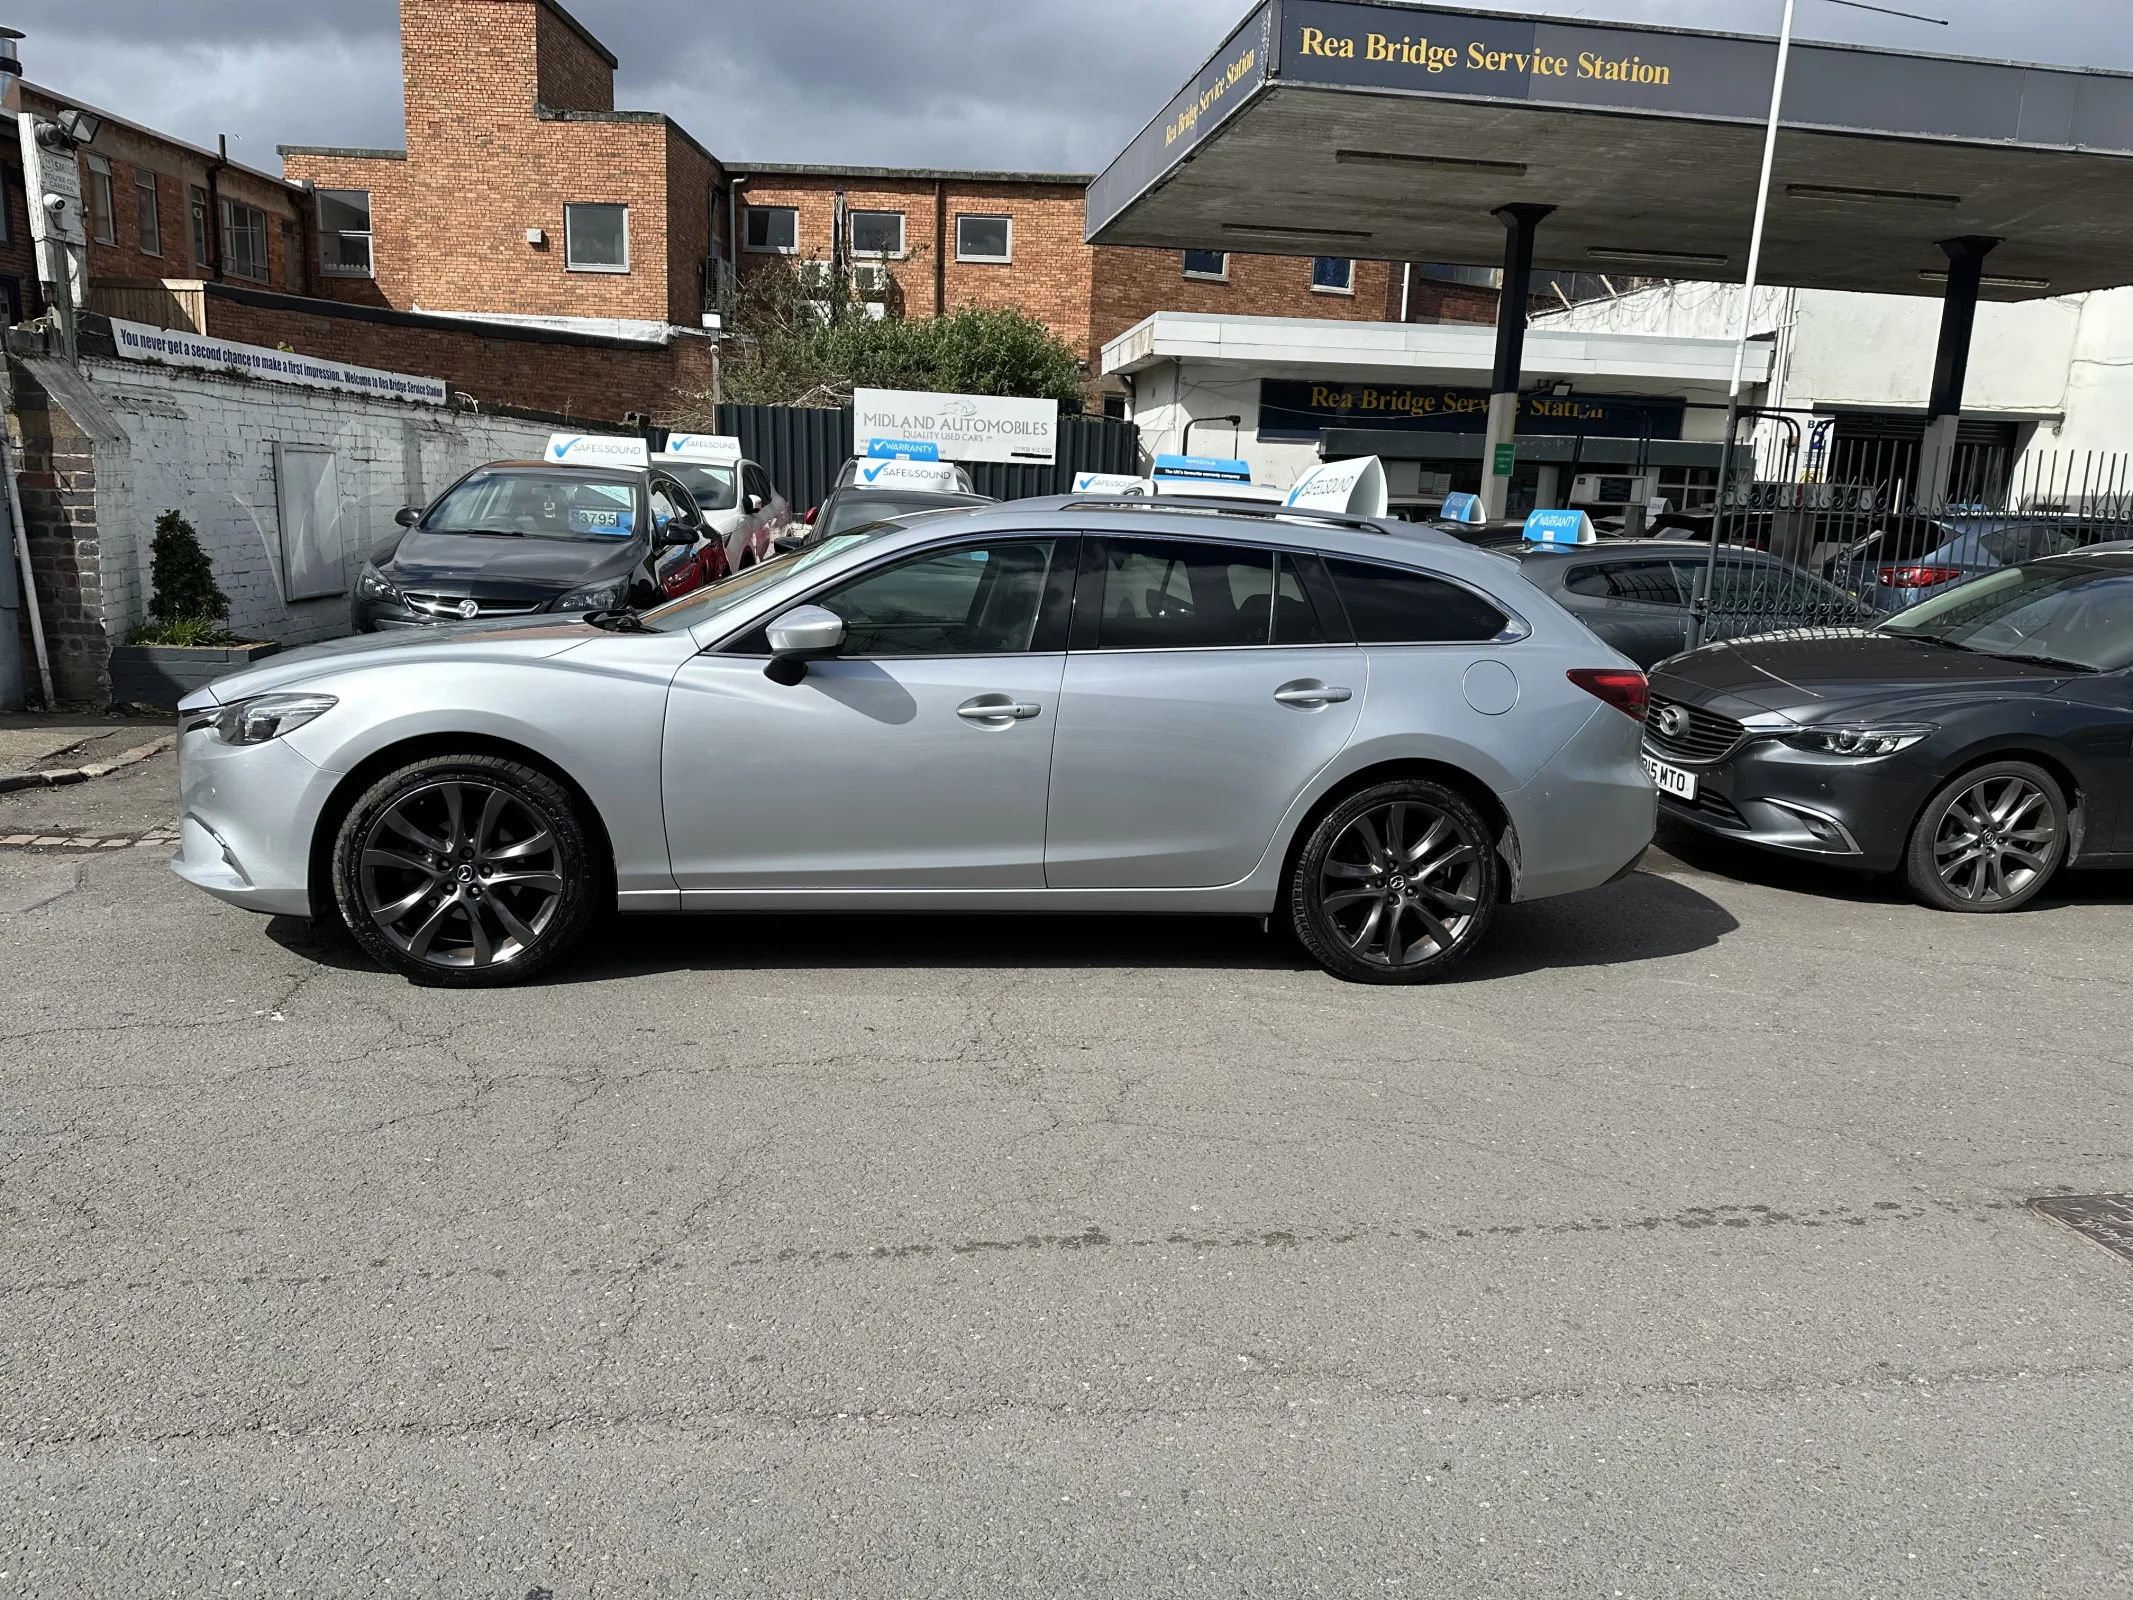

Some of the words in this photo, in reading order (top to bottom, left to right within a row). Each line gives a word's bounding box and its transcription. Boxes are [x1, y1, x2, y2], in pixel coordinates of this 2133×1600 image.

[1299, 26, 1354, 58] Rea
[1364, 32, 1458, 73] Bridge
[1466, 41, 1568, 77] Service
[1576, 50, 1670, 85] Station
[1165, 124, 1177, 148] Rea
[1177, 103, 1199, 135] Bridge
[1199, 77, 1225, 115] Service
[1225, 48, 1255, 89] Station
[49, 180, 74, 193] CAMERA
[67, 178, 77, 187] ON
[120, 328, 139, 346] You
[139, 334, 166, 351] never
[167, 339, 183, 355] get
[183, 343, 190, 356] a
[191, 344, 222, 362] second
[222, 349, 252, 366] chance
[252, 354, 261, 368] to
[261, 356, 282, 373] make
[282, 363, 288, 373] a
[288, 360, 303, 376] first
[344, 370, 372, 387] Welcome
[372, 376, 378, 388] to
[378, 376, 389, 390] Rea
[389, 378, 407, 394] Bridge
[407, 381, 426, 396] Service
[426, 385, 443, 398] Station
[1311, 386, 1353, 408] Rea
[1361, 388, 1436, 417] Bridge
[1442, 391, 1520, 414] Serve
[1530, 400, 1604, 419] Statin
[863, 412, 935, 430] MIDLAND
[940, 417, 1048, 436] AUTOMOBILES
[903, 430, 939, 440] QUALITY
[941, 433, 960, 441] USED
[962, 434, 983, 442] CARS
[572, 442, 641, 455] SAFE&SOUND
[685, 439, 736, 450] SAFE&SOUND
[885, 442, 933, 454] WARRANTY
[883, 467, 951, 480] SAFE&SOUND
[1301, 475, 1355, 497] SAFE&SOUND
[1538, 515, 1578, 528] WARRANTY
[1660, 765, 1686, 791] MTO
